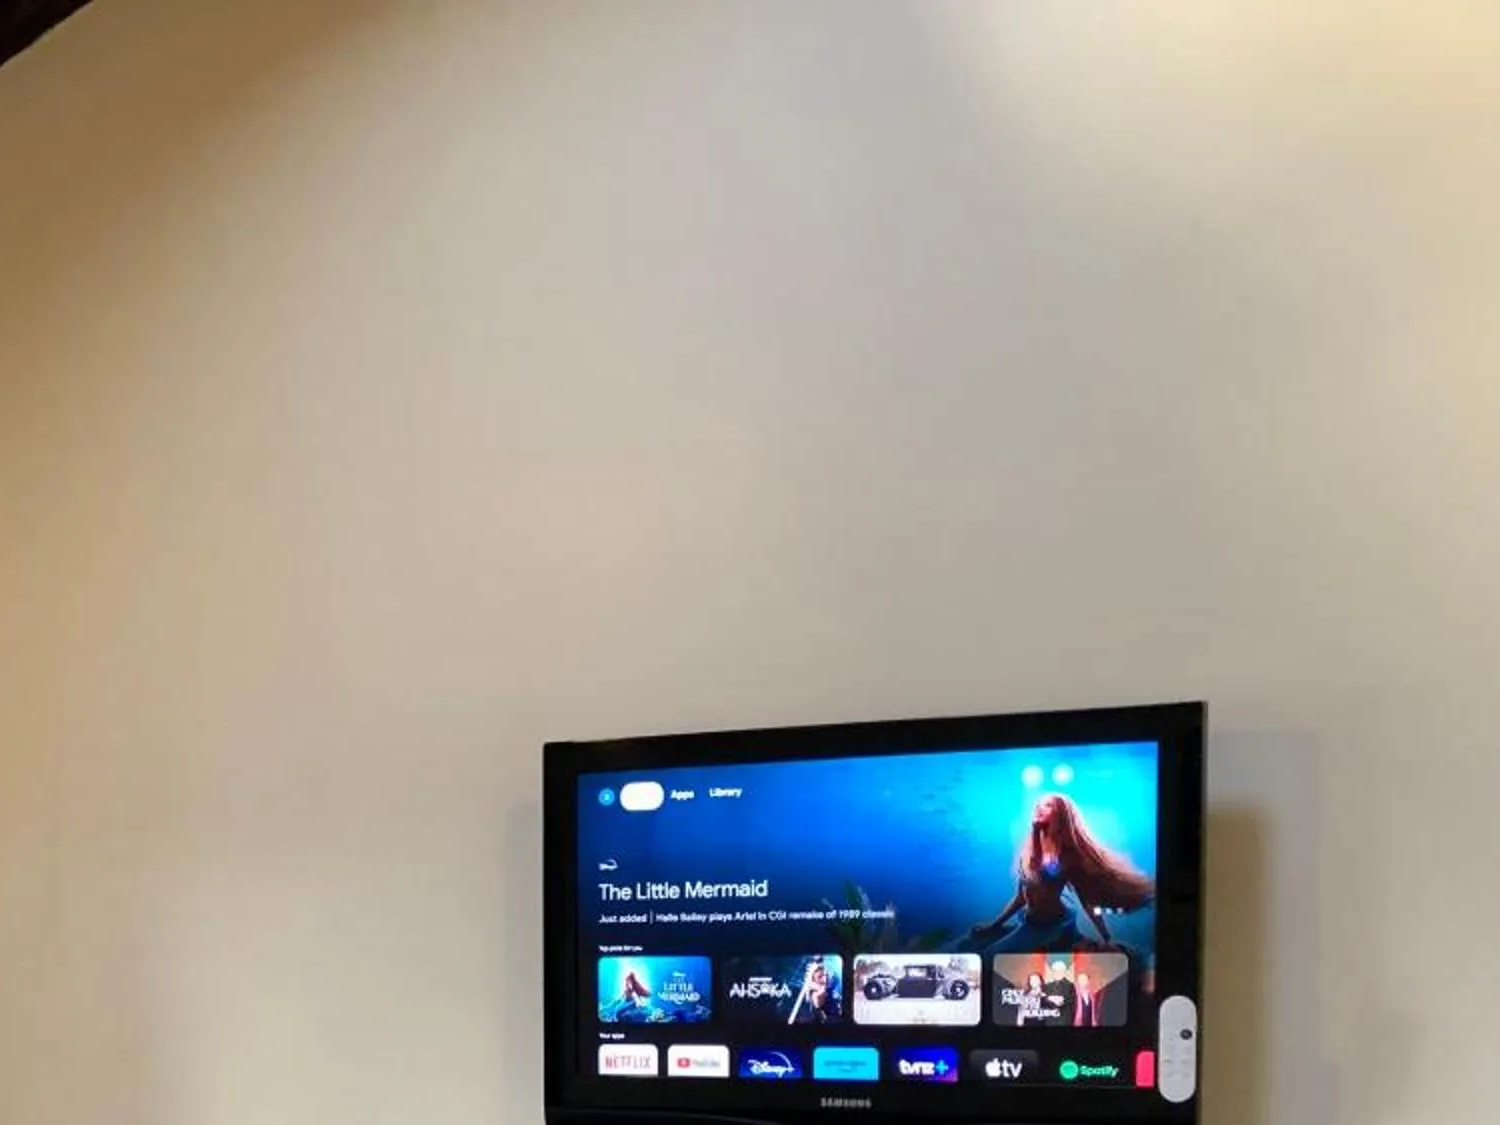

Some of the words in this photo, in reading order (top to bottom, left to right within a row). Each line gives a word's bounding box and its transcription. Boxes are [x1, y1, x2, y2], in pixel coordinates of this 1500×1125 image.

[670, 789, 695, 801] Apps
[709, 787, 743, 799] Library
[598, 883, 632, 901] The
[636, 882, 681, 900] Little
[685, 879, 769, 898] Mermaid
[599, 914, 617, 924] Just
[619, 914, 647, 924] added
[768, 910, 787, 921] CGI
[826, 909, 838, 919] of
[605, 1055, 652, 1069] NETFLIX
[1079, 1063, 1120, 1079] Spotify
